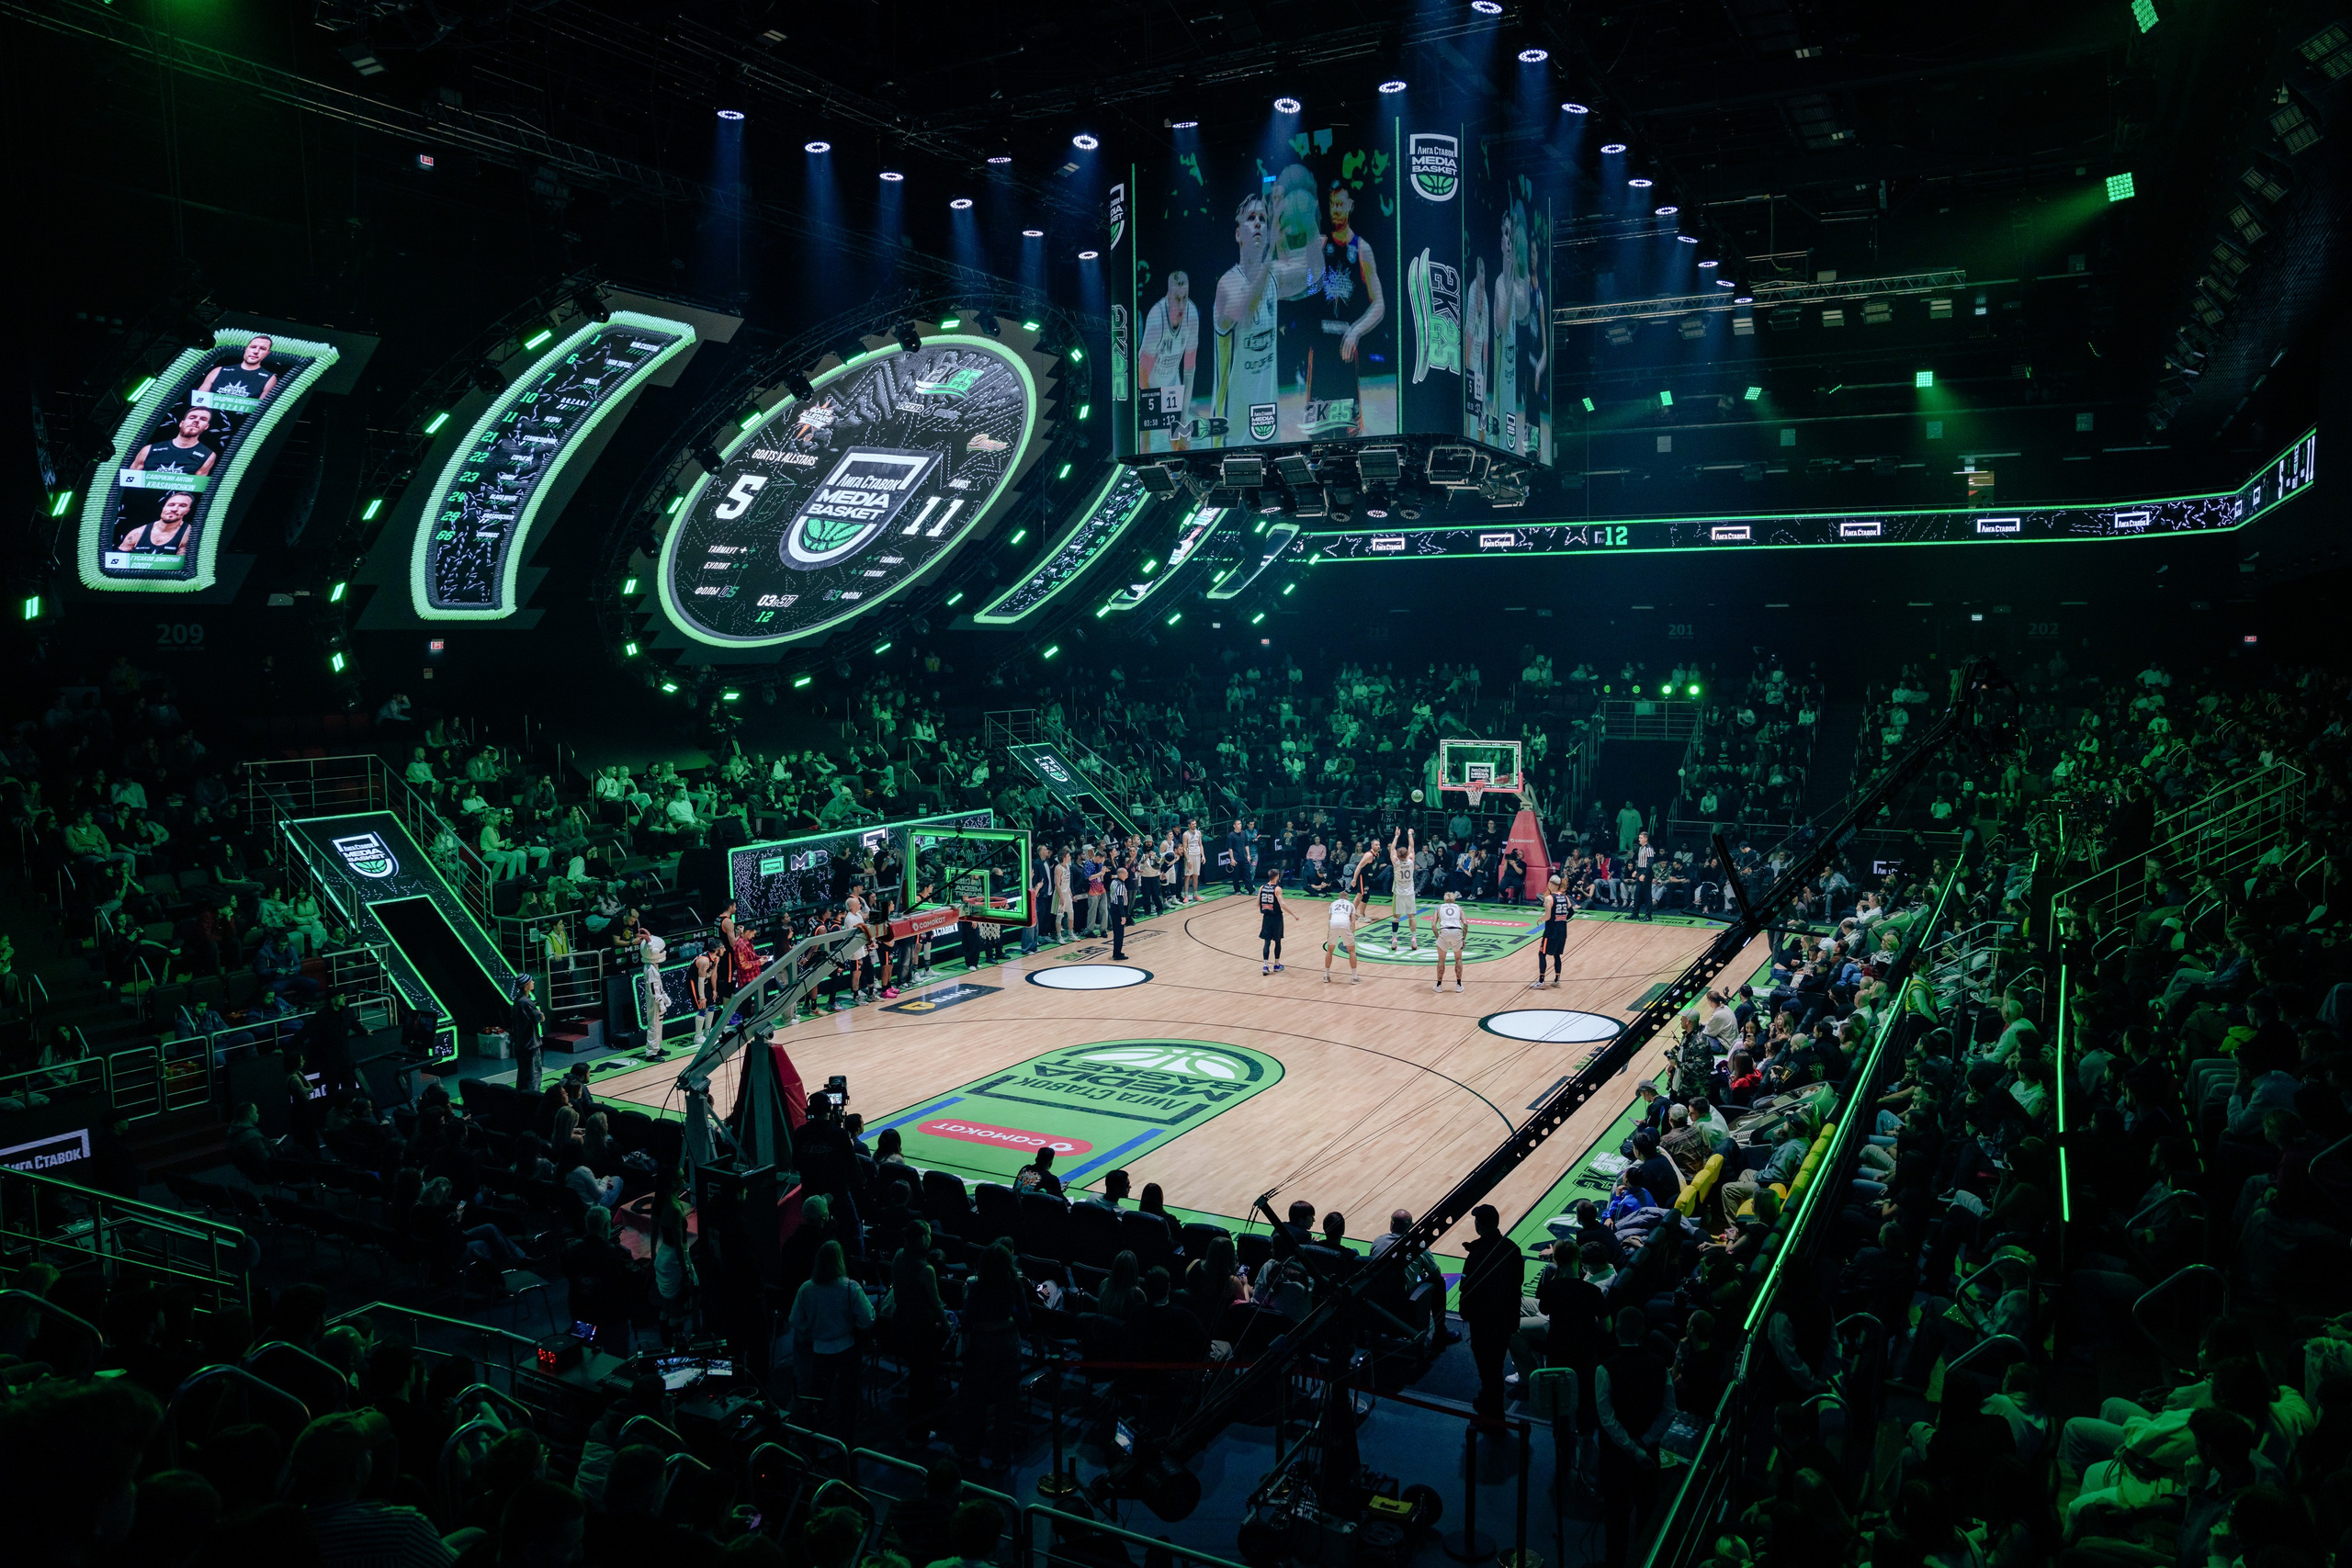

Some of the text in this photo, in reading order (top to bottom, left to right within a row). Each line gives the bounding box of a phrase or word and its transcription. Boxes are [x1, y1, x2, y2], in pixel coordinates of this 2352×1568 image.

[1412, 156, 1457, 169] MEDIA
[1412, 165, 1458, 175] BASKET
[566, 353, 580, 365] 6
[520, 391, 539, 403] 10
[1166, 397, 1178, 409] 11
[1148, 399, 1155, 411] 5
[502, 412, 519, 423] 11
[481, 431, 500, 443] 21
[469, 452, 490, 463] 22
[752, 448, 778, 462] GOATS
[782, 452, 819, 467] ALLSTARS
[458, 471, 481, 483] 23
[145, 481, 197, 491] KRASAVOCHKIN
[716, 474, 769, 520] 5
[816, 489, 890, 509] MEDIA
[807, 502, 887, 521] BASKET
[901, 496, 966, 537] 11
[1605, 526, 1628, 546] 12
[707, 544, 739, 555] ТАЙМАУТ
[703, 561, 731, 570] БУЛЛИТ
[695, 586, 721, 596] ФОЛЫ
[754, 611, 775, 623] 12
[156, 624, 204, 644] 209
[1668, 624, 1694, 635] 201
[343, 848, 384, 859] MEDIA
[346, 853, 386, 863] BASKET
[1400, 870, 1411, 879] 10
[1334, 904, 1350, 912] 24
[1055, 1059, 1251, 1093] BASKET
[1012, 1077, 1112, 1100] СТАВОК
[1033, 1064, 1236, 1103] MEDIA
[34, 1147, 83, 1170] СТАВОК
